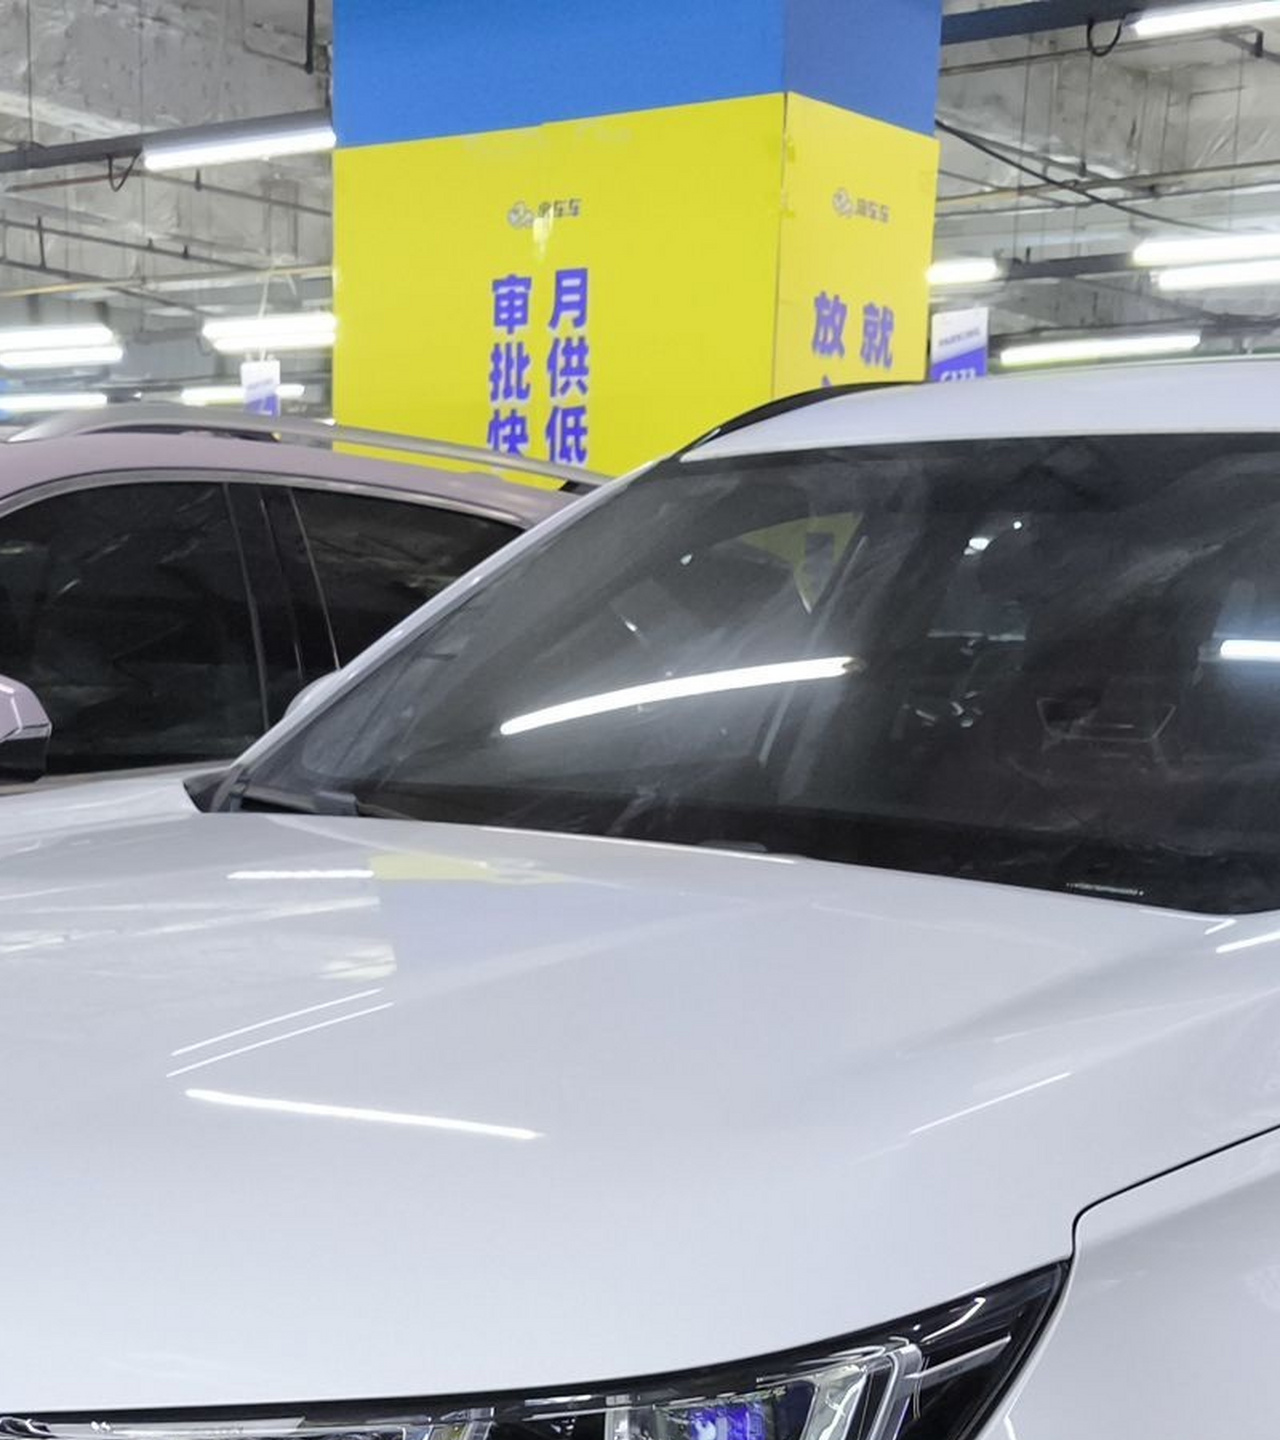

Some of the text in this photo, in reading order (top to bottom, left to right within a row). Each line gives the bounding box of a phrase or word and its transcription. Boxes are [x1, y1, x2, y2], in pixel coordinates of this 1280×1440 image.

[487, 274, 532, 457] 审批快
[545, 268, 590, 462] 月供低
[811, 289, 847, 386] 放
